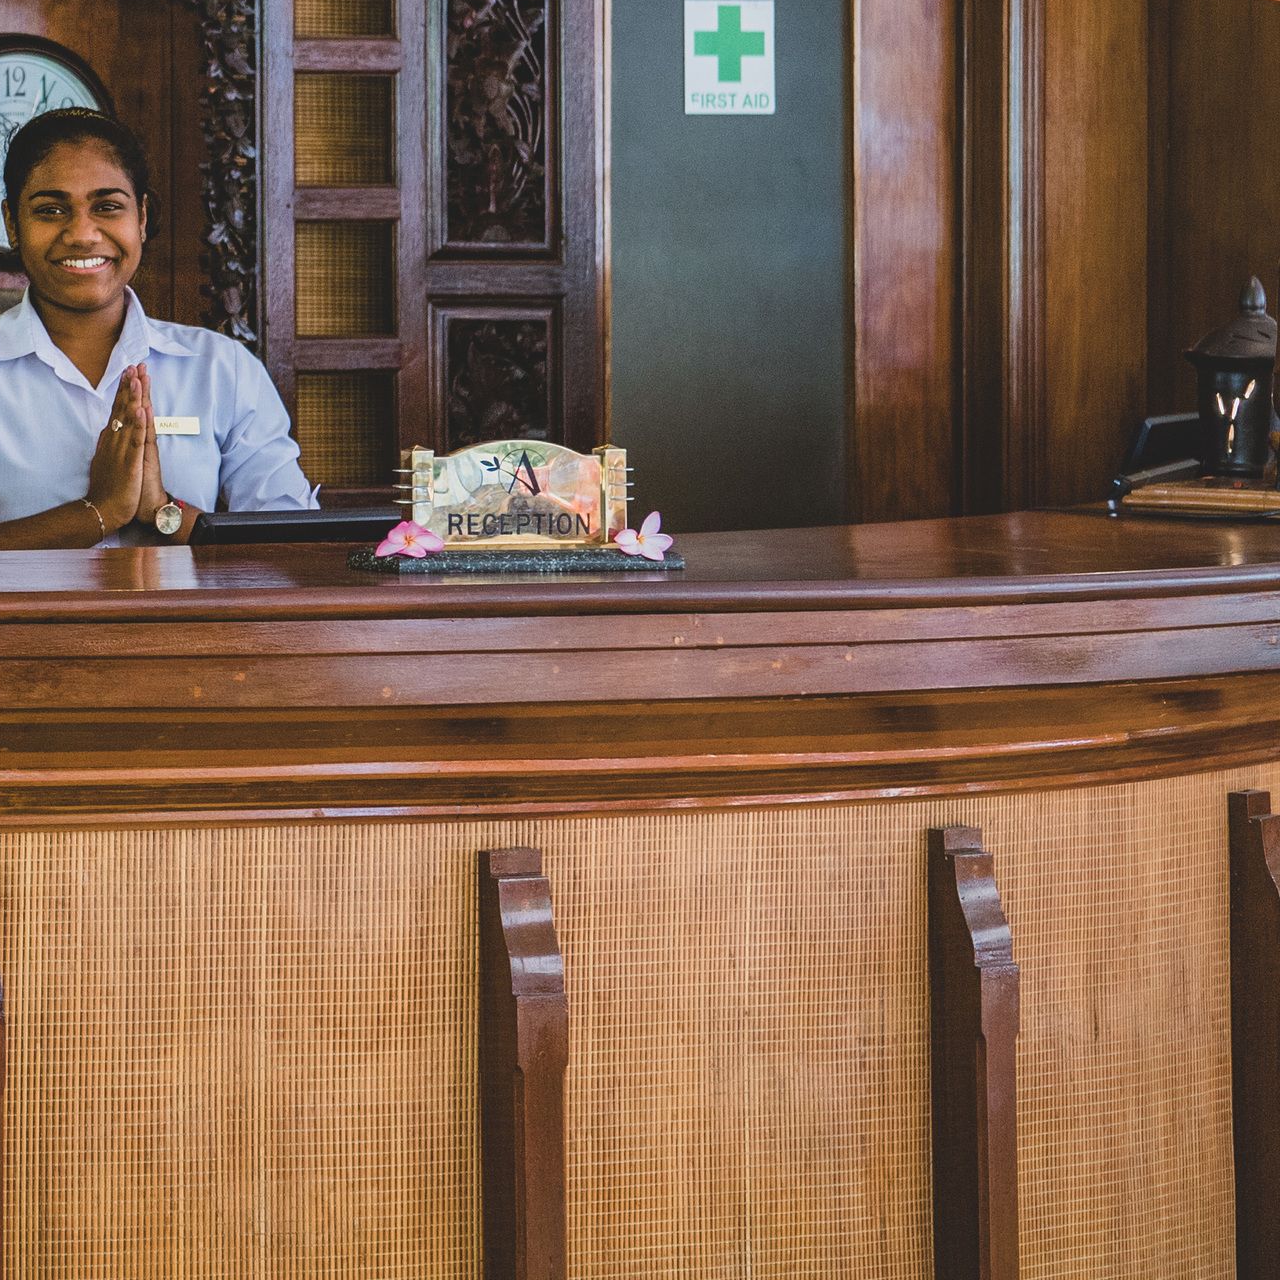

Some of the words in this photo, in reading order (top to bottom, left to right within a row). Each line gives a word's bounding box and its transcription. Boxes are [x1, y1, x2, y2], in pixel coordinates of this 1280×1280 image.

[3, 66, 26, 98] 12
[39, 73, 48, 104] 1
[691, 93, 737, 109] FIRST
[742, 93, 770, 109] AID
[447, 513, 591, 536] RECEPTION
